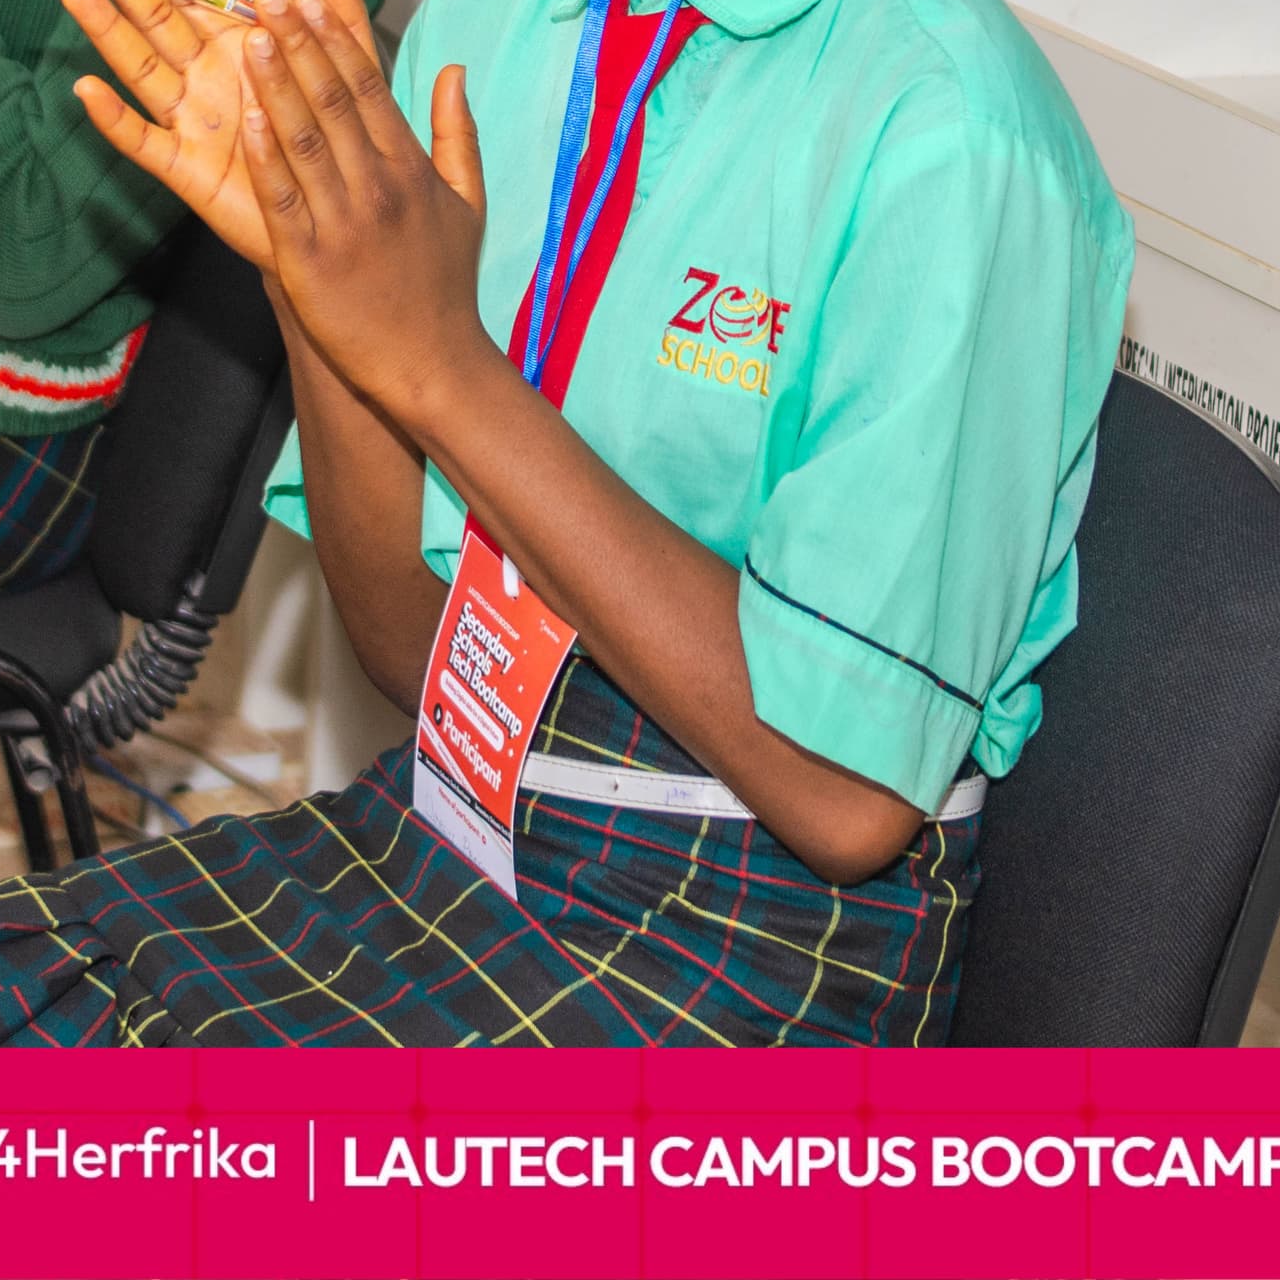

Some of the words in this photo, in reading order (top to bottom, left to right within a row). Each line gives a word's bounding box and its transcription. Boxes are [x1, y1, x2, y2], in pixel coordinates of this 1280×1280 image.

[454, 622, 493, 678] Schools
[461, 602, 516, 675] Secondary
[450, 641, 475, 689] Tech
[470, 664, 523, 739] Bootcamp
[443, 709, 504, 793] Participant
